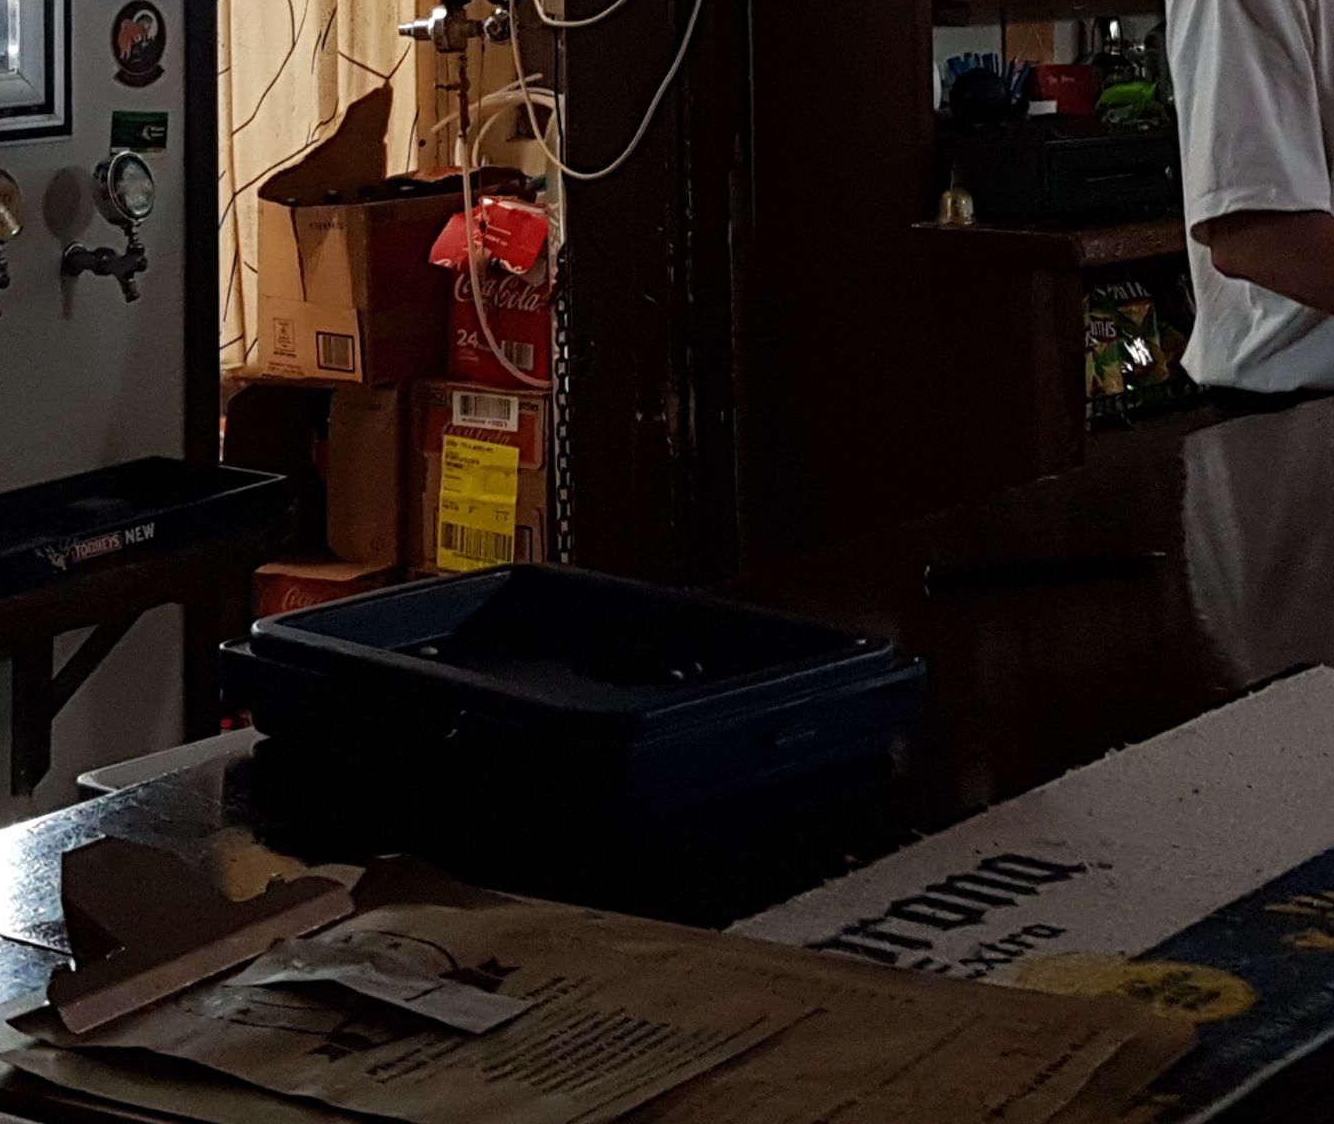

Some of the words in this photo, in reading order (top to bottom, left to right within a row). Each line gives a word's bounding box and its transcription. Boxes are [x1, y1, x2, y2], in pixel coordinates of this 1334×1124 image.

[456, 328, 480, 348] 24
[124, 522, 155, 546] NEW
[805, 853, 1088, 966] rona
